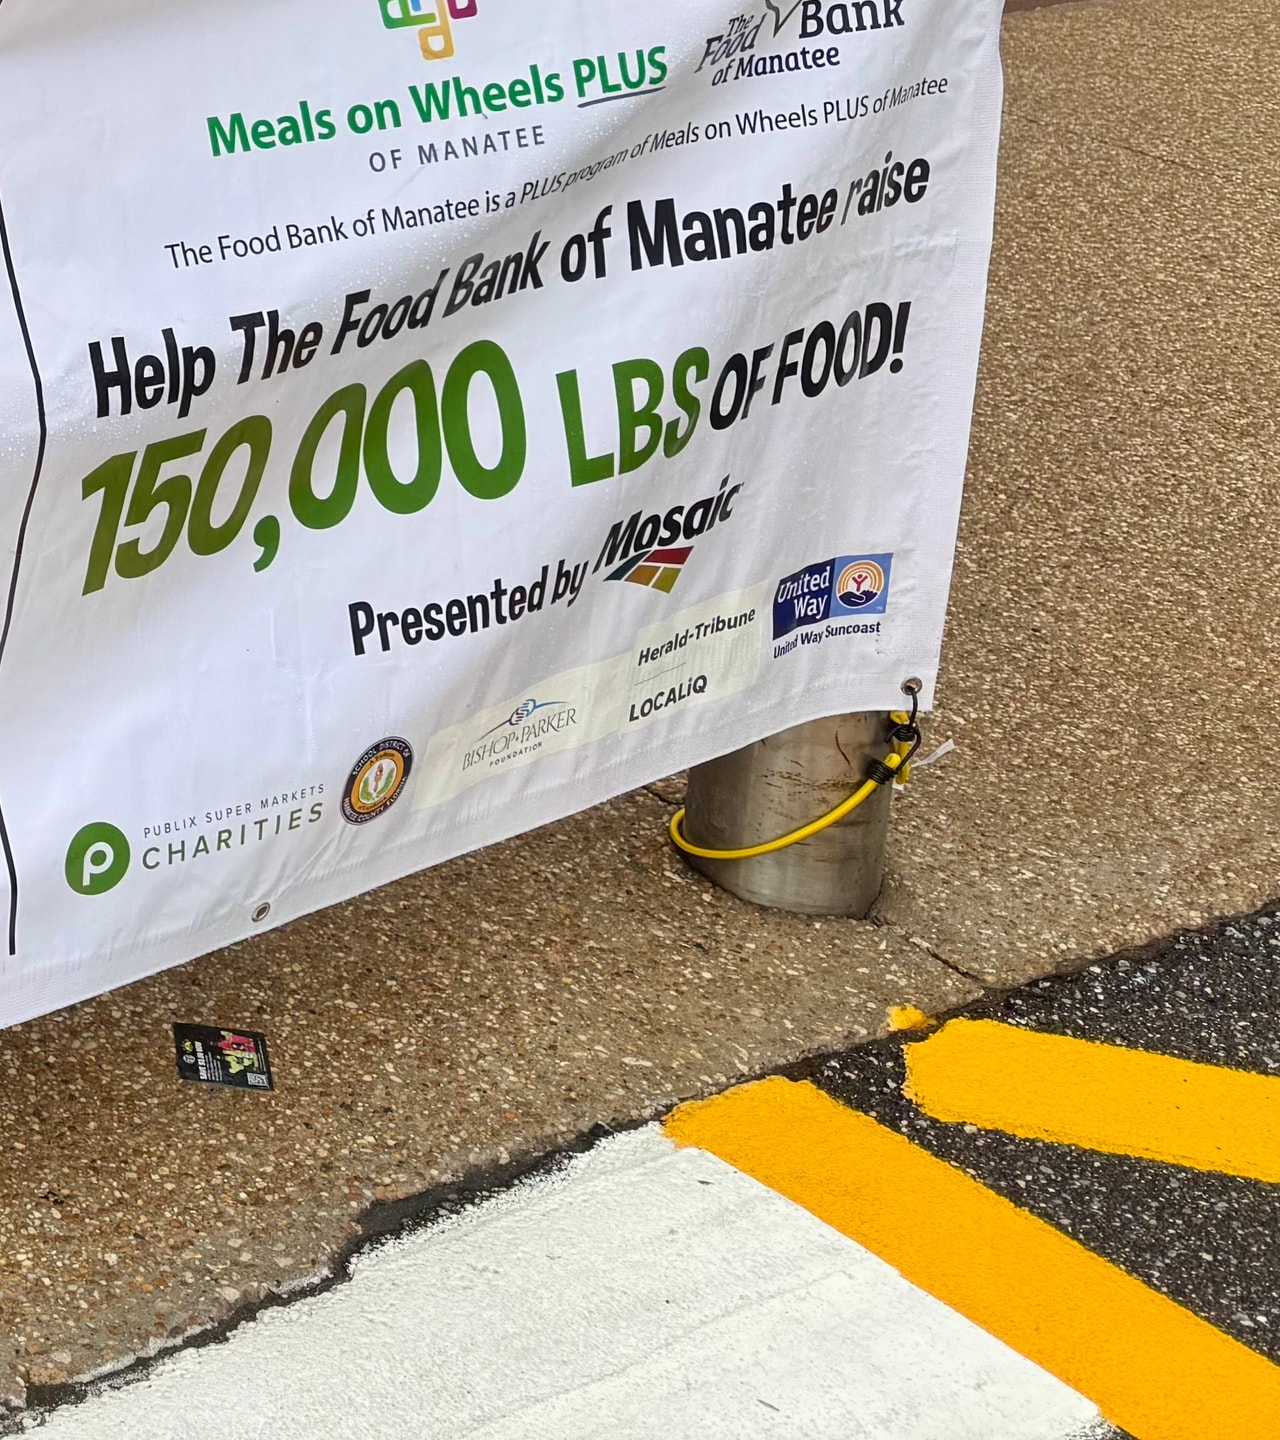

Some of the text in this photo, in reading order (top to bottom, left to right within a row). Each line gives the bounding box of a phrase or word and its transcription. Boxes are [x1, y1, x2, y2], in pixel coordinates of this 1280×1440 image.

[694, 12, 767, 73] Food
[728, 13, 755, 37] The
[712, 46, 841, 86] of Manatee
[206, 44, 669, 157] Meals on Wheels PLUS
[164, 77, 948, 270] The Food Bank of Manatee is a PLUS program of Meals on Wheels PLUS of Manatee
[369, 125, 546, 172] OF MANATEE
[89, 150, 932, 419] Help The Food Bank of Manatee raise
[80, 299, 914, 597] 150,000 LBS OF FOOD!
[347, 473, 743, 658] Presented by Mosaic
[777, 565, 830, 603] United
[793, 594, 828, 621] Way
[637, 608, 756, 666] Herald-Tribune
[773, 621, 881, 659] United Way Suncoast
[628, 674, 708, 723] LOCALiQ
[489, 741, 544, 768] FOUNDATION
[142, 802, 324, 870] CHARITIES
[143, 816, 197, 839] PUBLIX
[205, 802, 252, 824] SUPER
[260, 783, 325, 810] MARKETS
